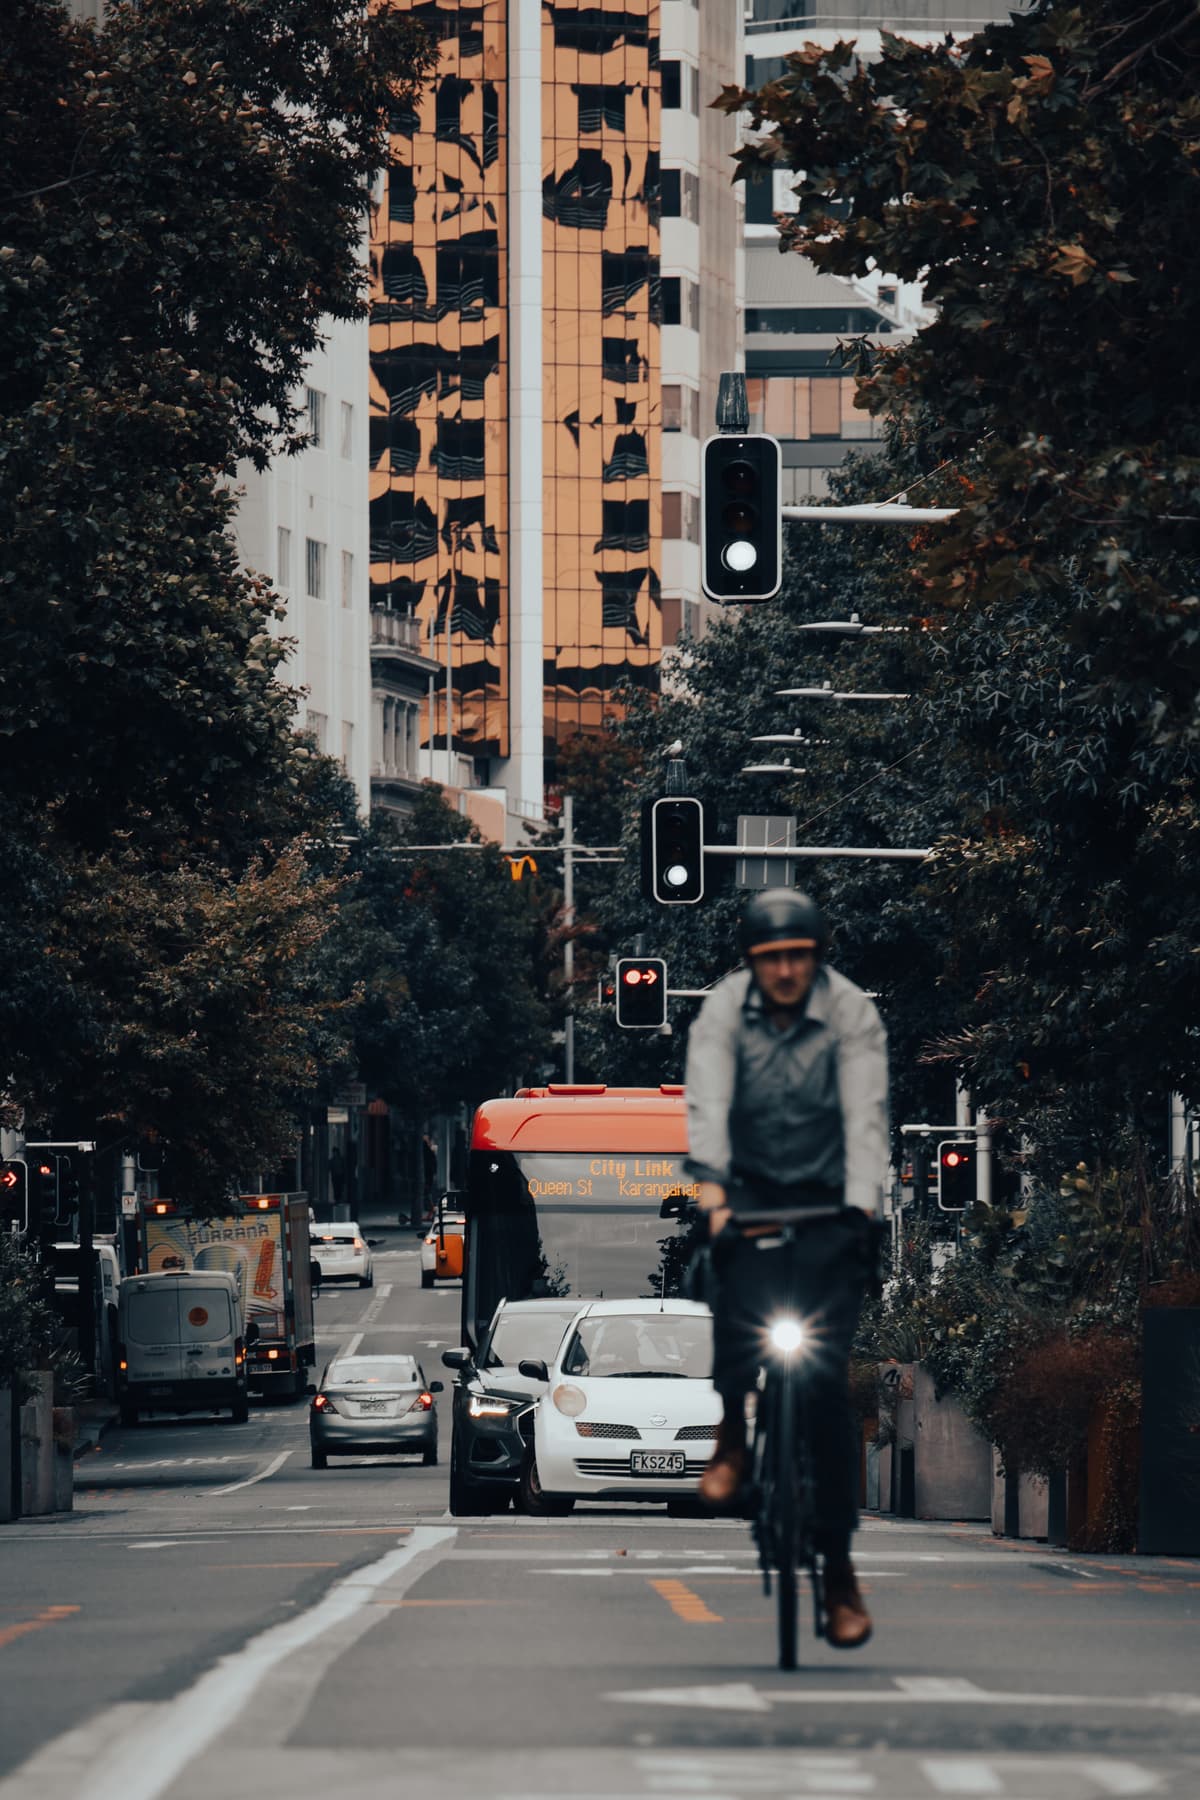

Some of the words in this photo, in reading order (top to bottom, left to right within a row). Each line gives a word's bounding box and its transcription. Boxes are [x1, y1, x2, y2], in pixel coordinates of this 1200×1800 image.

[590, 1160, 625, 1178] City
[635, 1160, 673, 1176] Link
[528, 1179, 572, 1197] Queen
[577, 1179, 593, 1195] St
[619, 1180, 703, 1199] Karangahap
[633, 1456, 682, 1469] FKS245
